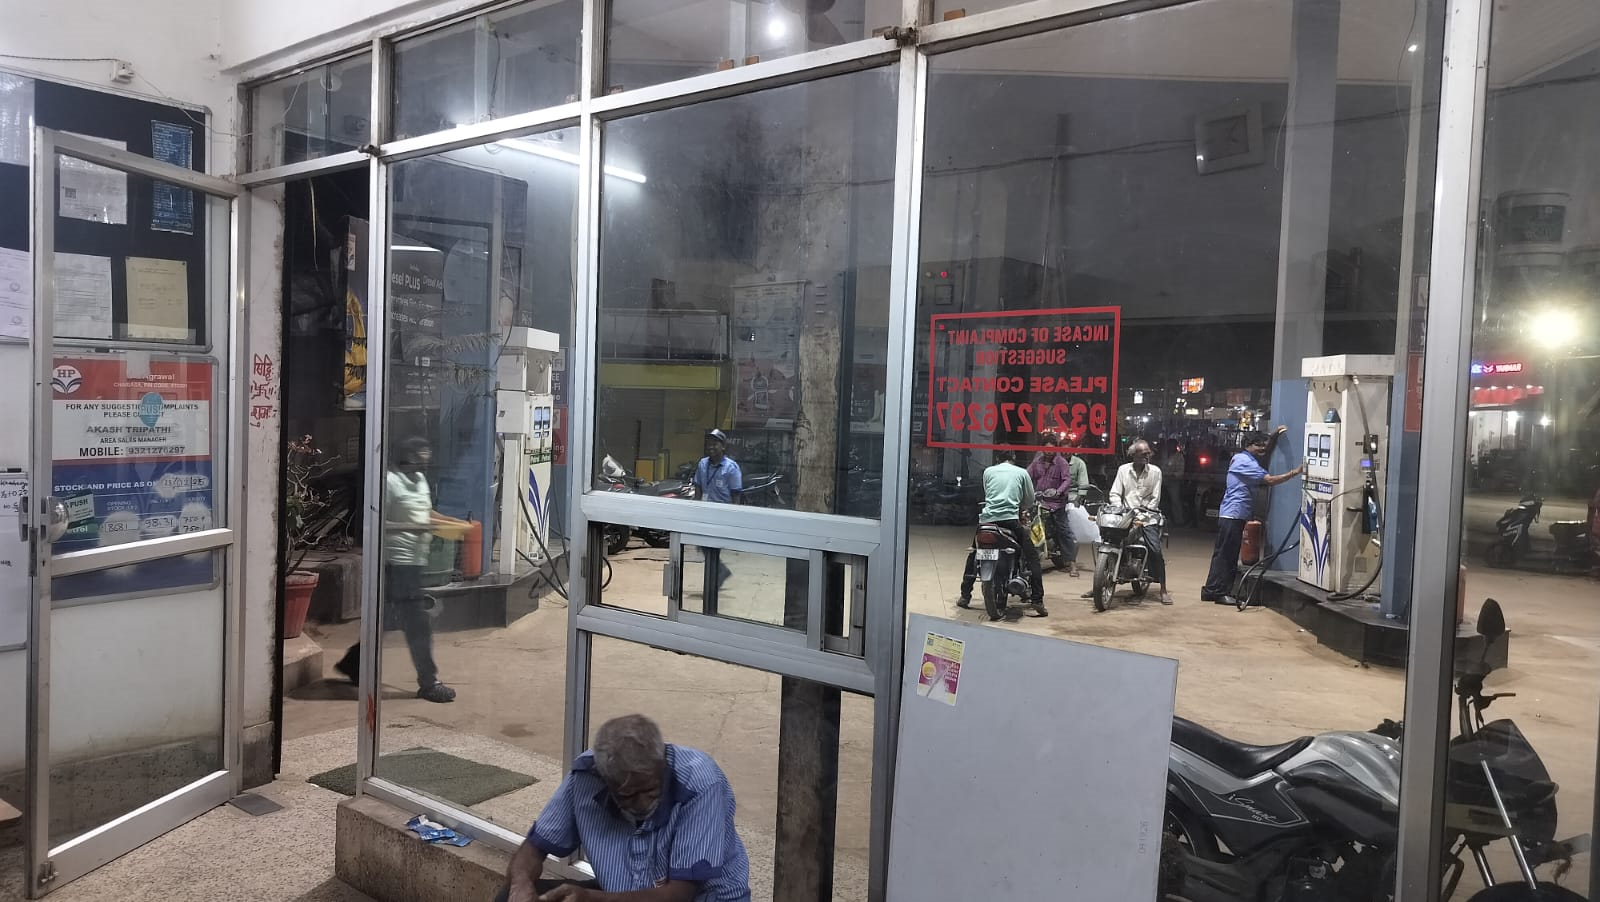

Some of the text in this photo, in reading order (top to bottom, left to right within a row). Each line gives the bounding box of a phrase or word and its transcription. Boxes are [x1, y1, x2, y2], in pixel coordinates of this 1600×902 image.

[405, 274, 420, 290] PLUS
[57, 369, 75, 377] HP
[86, 426, 171, 434] AKASH TRIPATHI
[79, 447, 123, 457] MOBILE:
[54, 484, 84, 492] STOCK
[70, 499, 89, 509] PUSH
